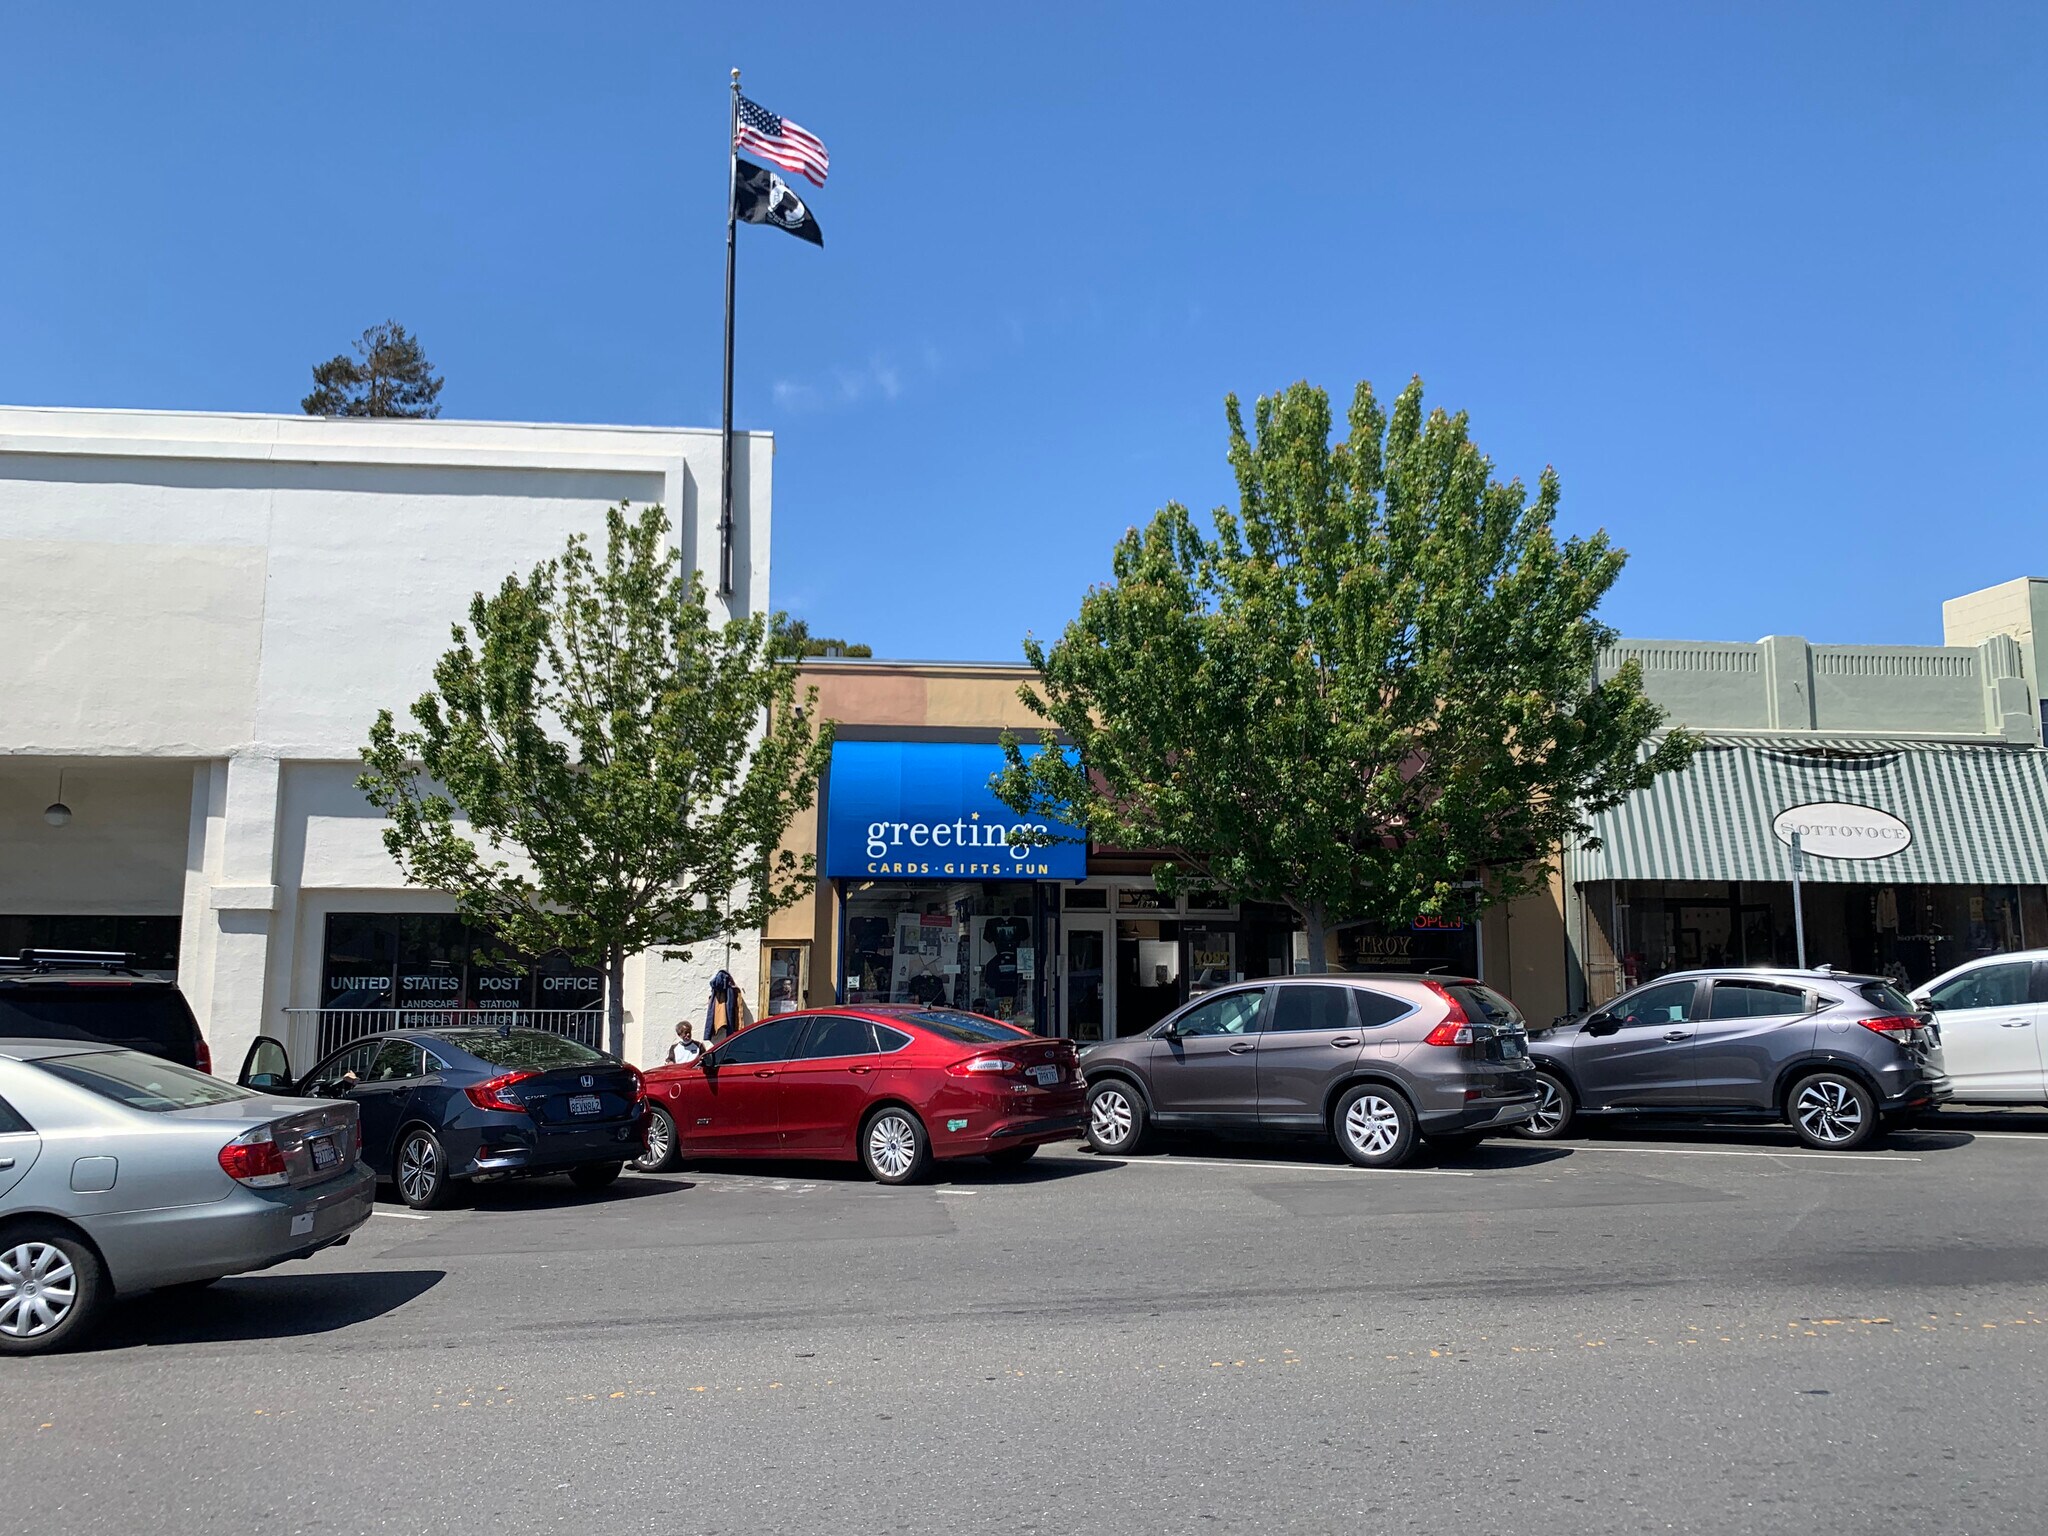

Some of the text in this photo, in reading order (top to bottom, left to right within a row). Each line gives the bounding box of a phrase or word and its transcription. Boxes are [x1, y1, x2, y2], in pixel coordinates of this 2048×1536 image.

[867, 812, 1048, 859] greetings
[1780, 821, 1906, 839] SOTTOVOCE
[867, 863, 1049, 874] CARDS GIFTS FUN
[1414, 915, 1461, 928] OPEN
[1355, 936, 1412, 955] TROY
[331, 977, 598, 990] UNITED STATES POST OFFICE
[401, 1000, 519, 1008] LANDSCAPE STATION
[403, 1015, 453, 1024] BERKELEY
